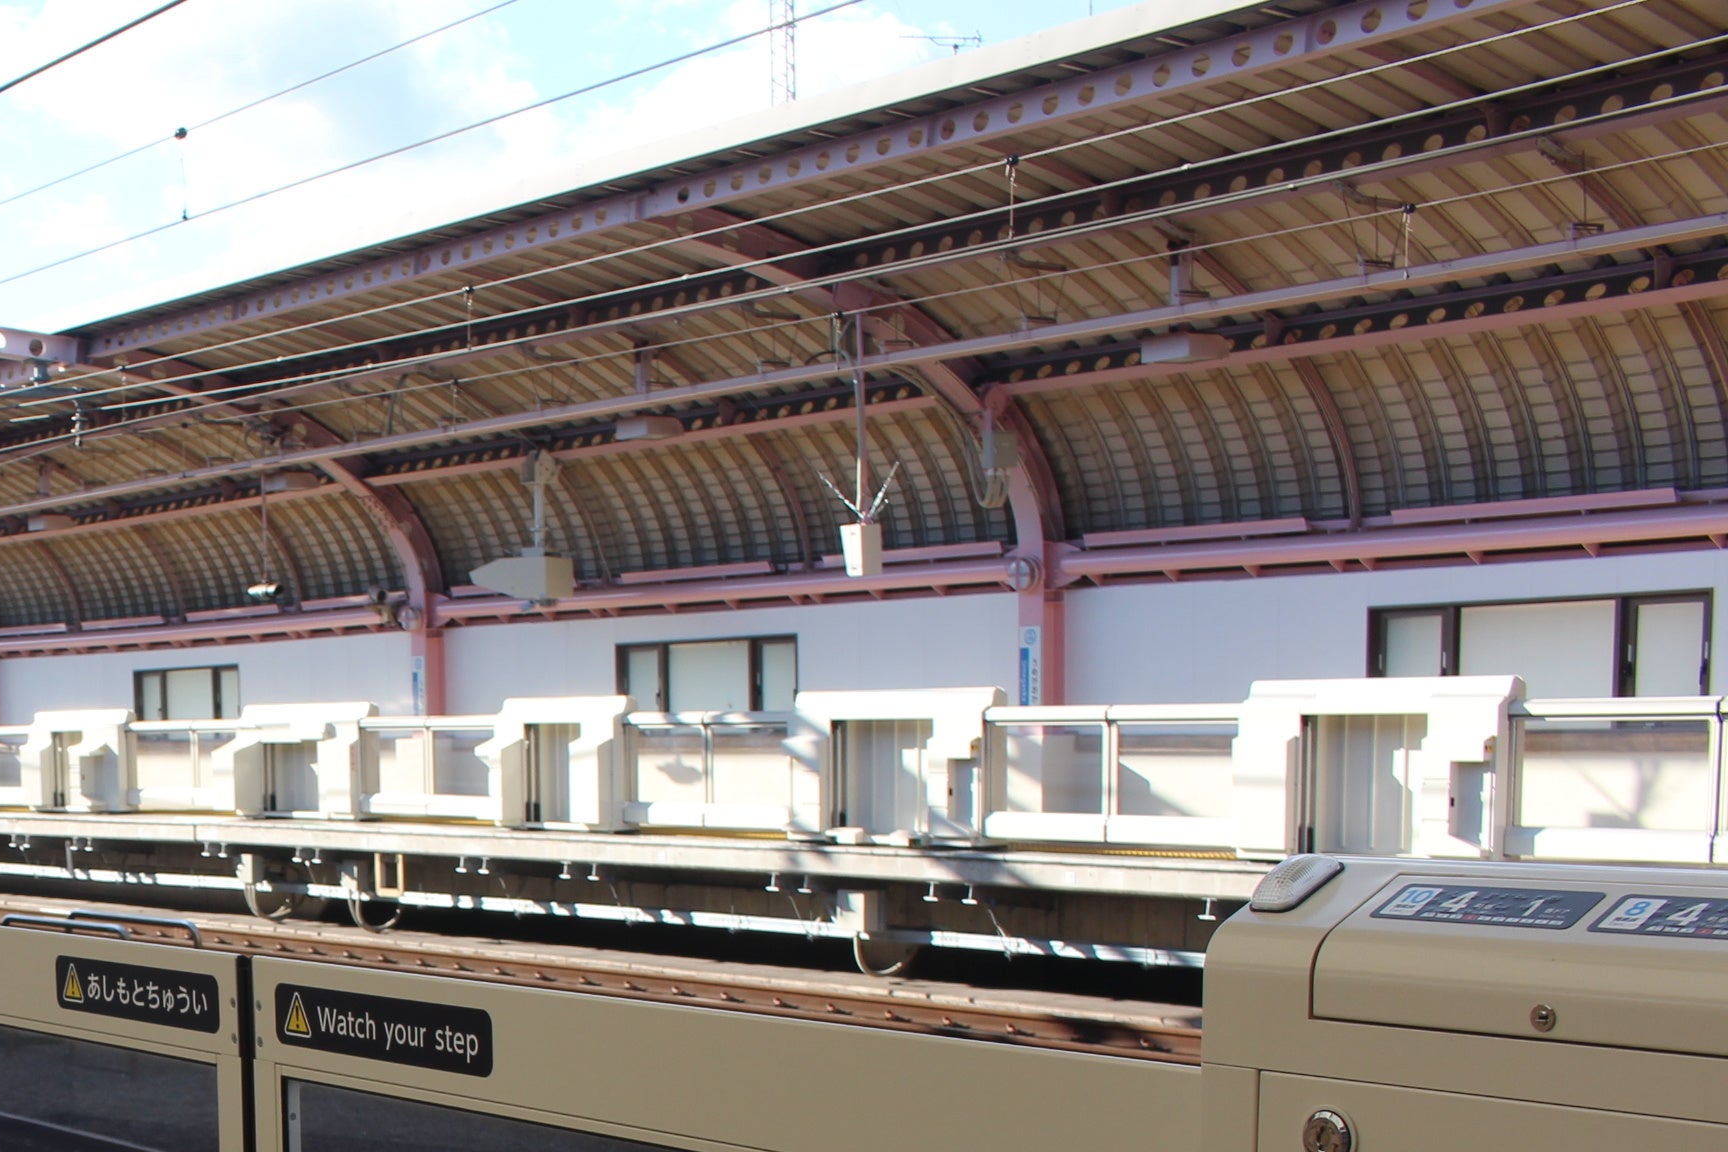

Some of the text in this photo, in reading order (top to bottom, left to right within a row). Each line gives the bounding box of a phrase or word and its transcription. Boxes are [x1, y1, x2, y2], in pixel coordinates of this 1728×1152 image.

[1400, 889, 1435, 904] 10
[1439, 891, 1546, 917] 4 1
[1624, 901, 1652, 917] 8
[1666, 902, 1711, 926] 4
[87, 972, 208, 1014] あしもとちゅうい
[317, 1005, 479, 1063] Watch your step
